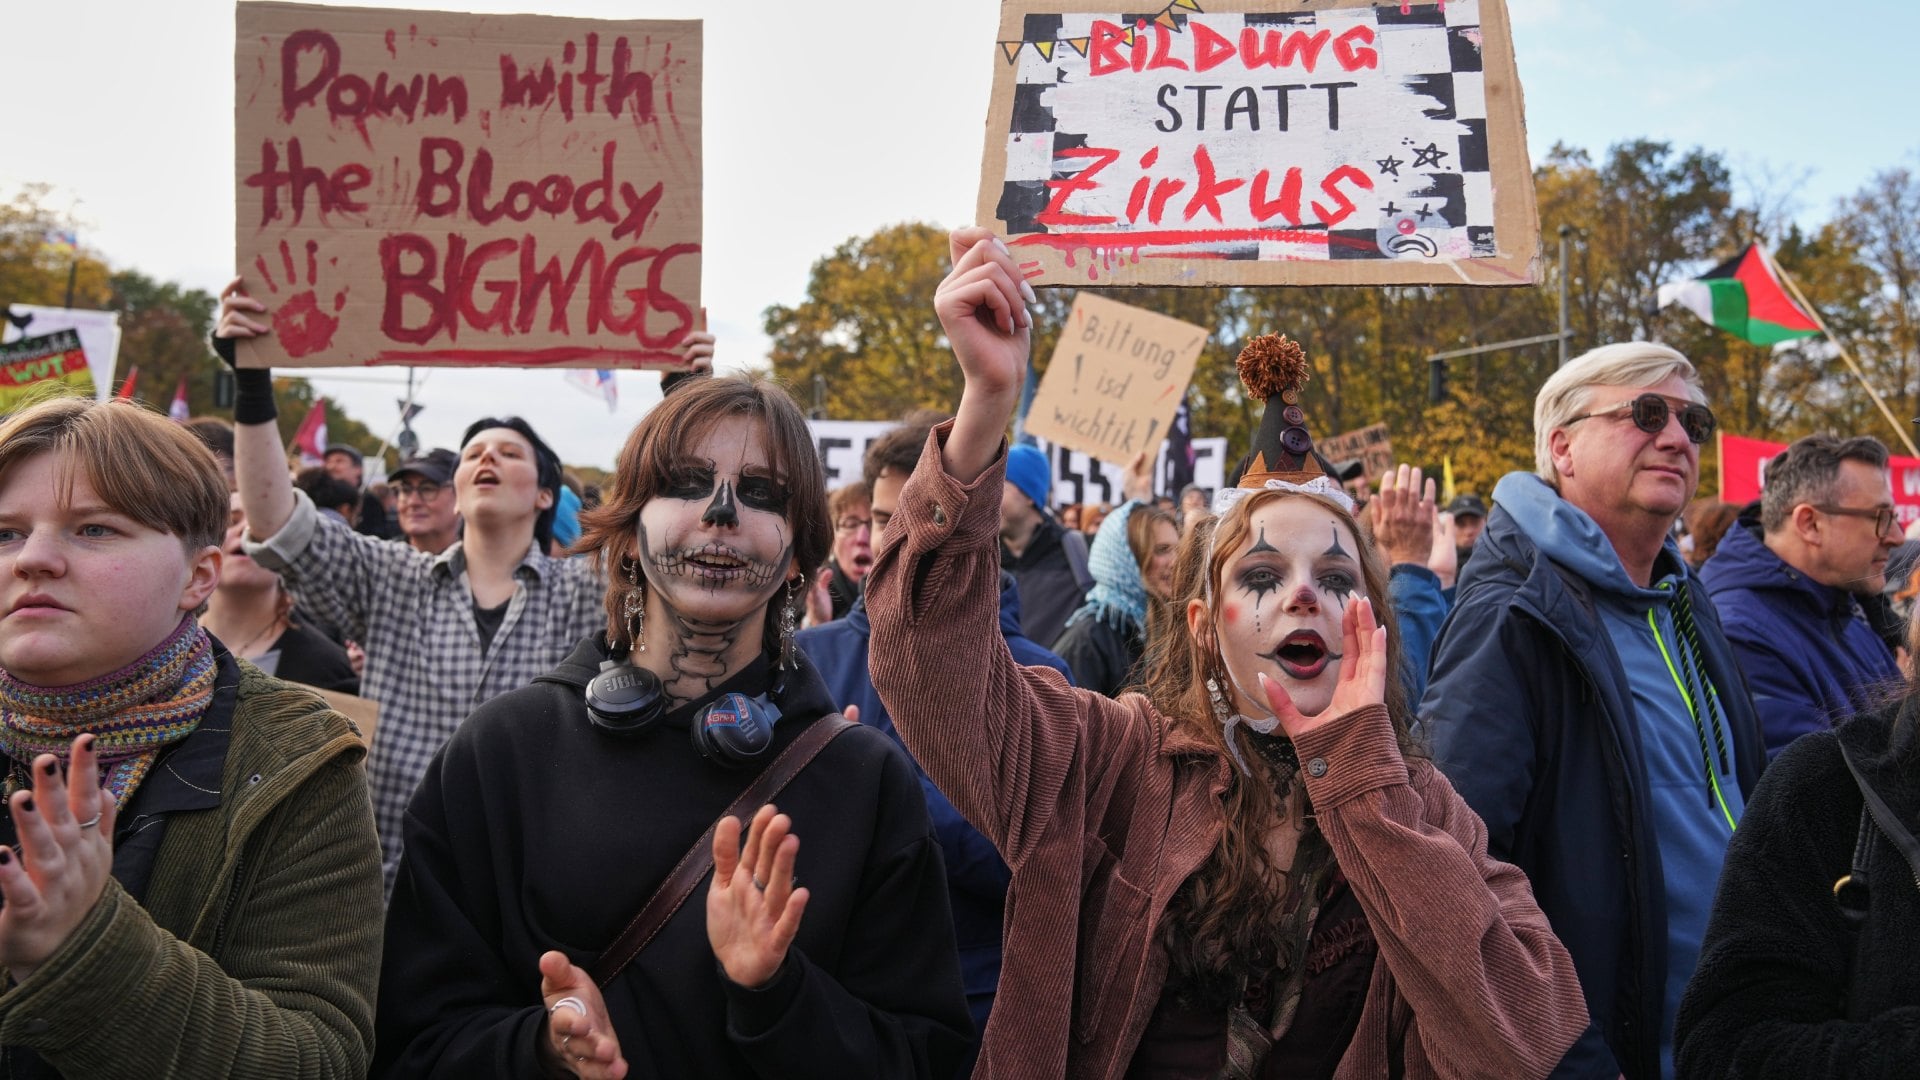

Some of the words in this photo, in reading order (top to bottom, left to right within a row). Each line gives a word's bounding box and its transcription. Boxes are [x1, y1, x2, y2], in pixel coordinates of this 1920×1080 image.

[281, 29, 469, 125] Down
[500, 32, 654, 123] with
[1155, 81, 1358, 132] STATT
[244, 137, 372, 228] the
[1033, 144, 1374, 227] Zirkus
[379, 232, 702, 349] BIGWIGS
[7, 353, 65, 384] WUT
[1095, 367, 1133, 401] isd
[604, 673, 643, 692] JBL
[739, 717, 760, 744] BL
